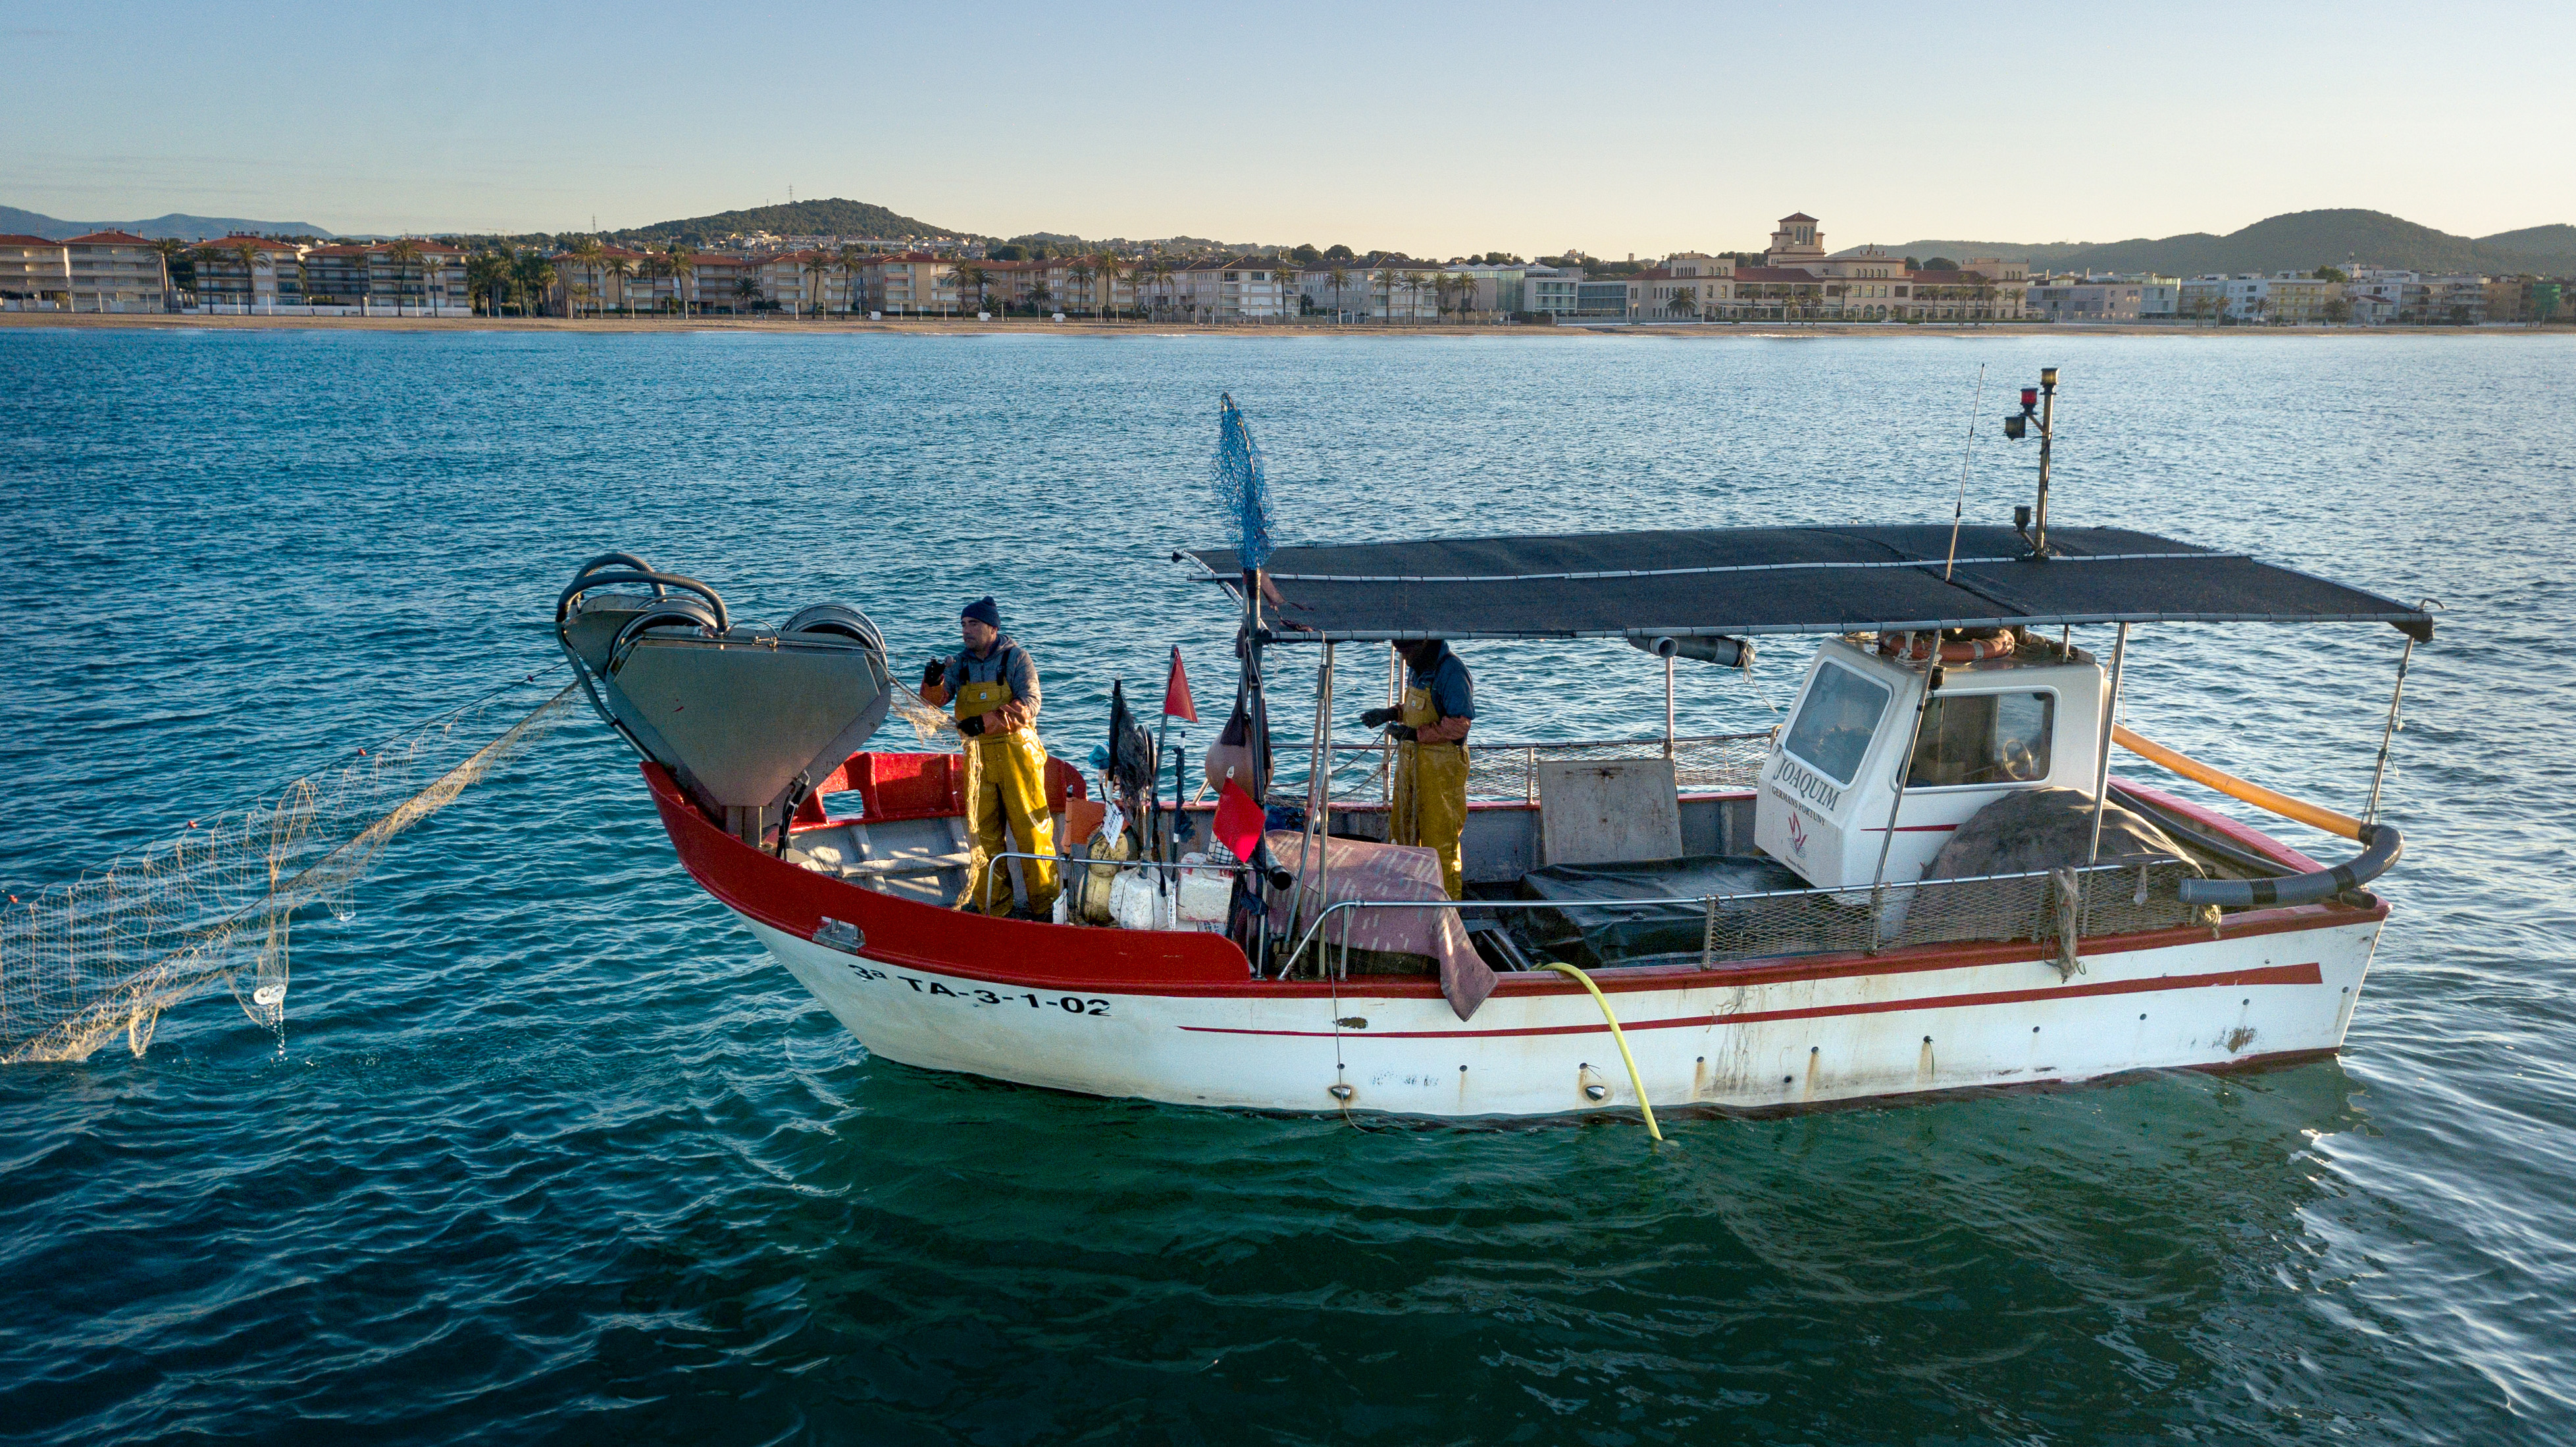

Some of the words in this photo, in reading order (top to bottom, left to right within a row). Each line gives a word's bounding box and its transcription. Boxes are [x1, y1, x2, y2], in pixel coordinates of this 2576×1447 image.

[1772, 786, 1798, 808] GERMANS
[1798, 801, 1826, 826] FORTUNY
[1773, 758, 1841, 812] JOAQUIM
[897, 975, 1112, 1017] TA-3-1-02
